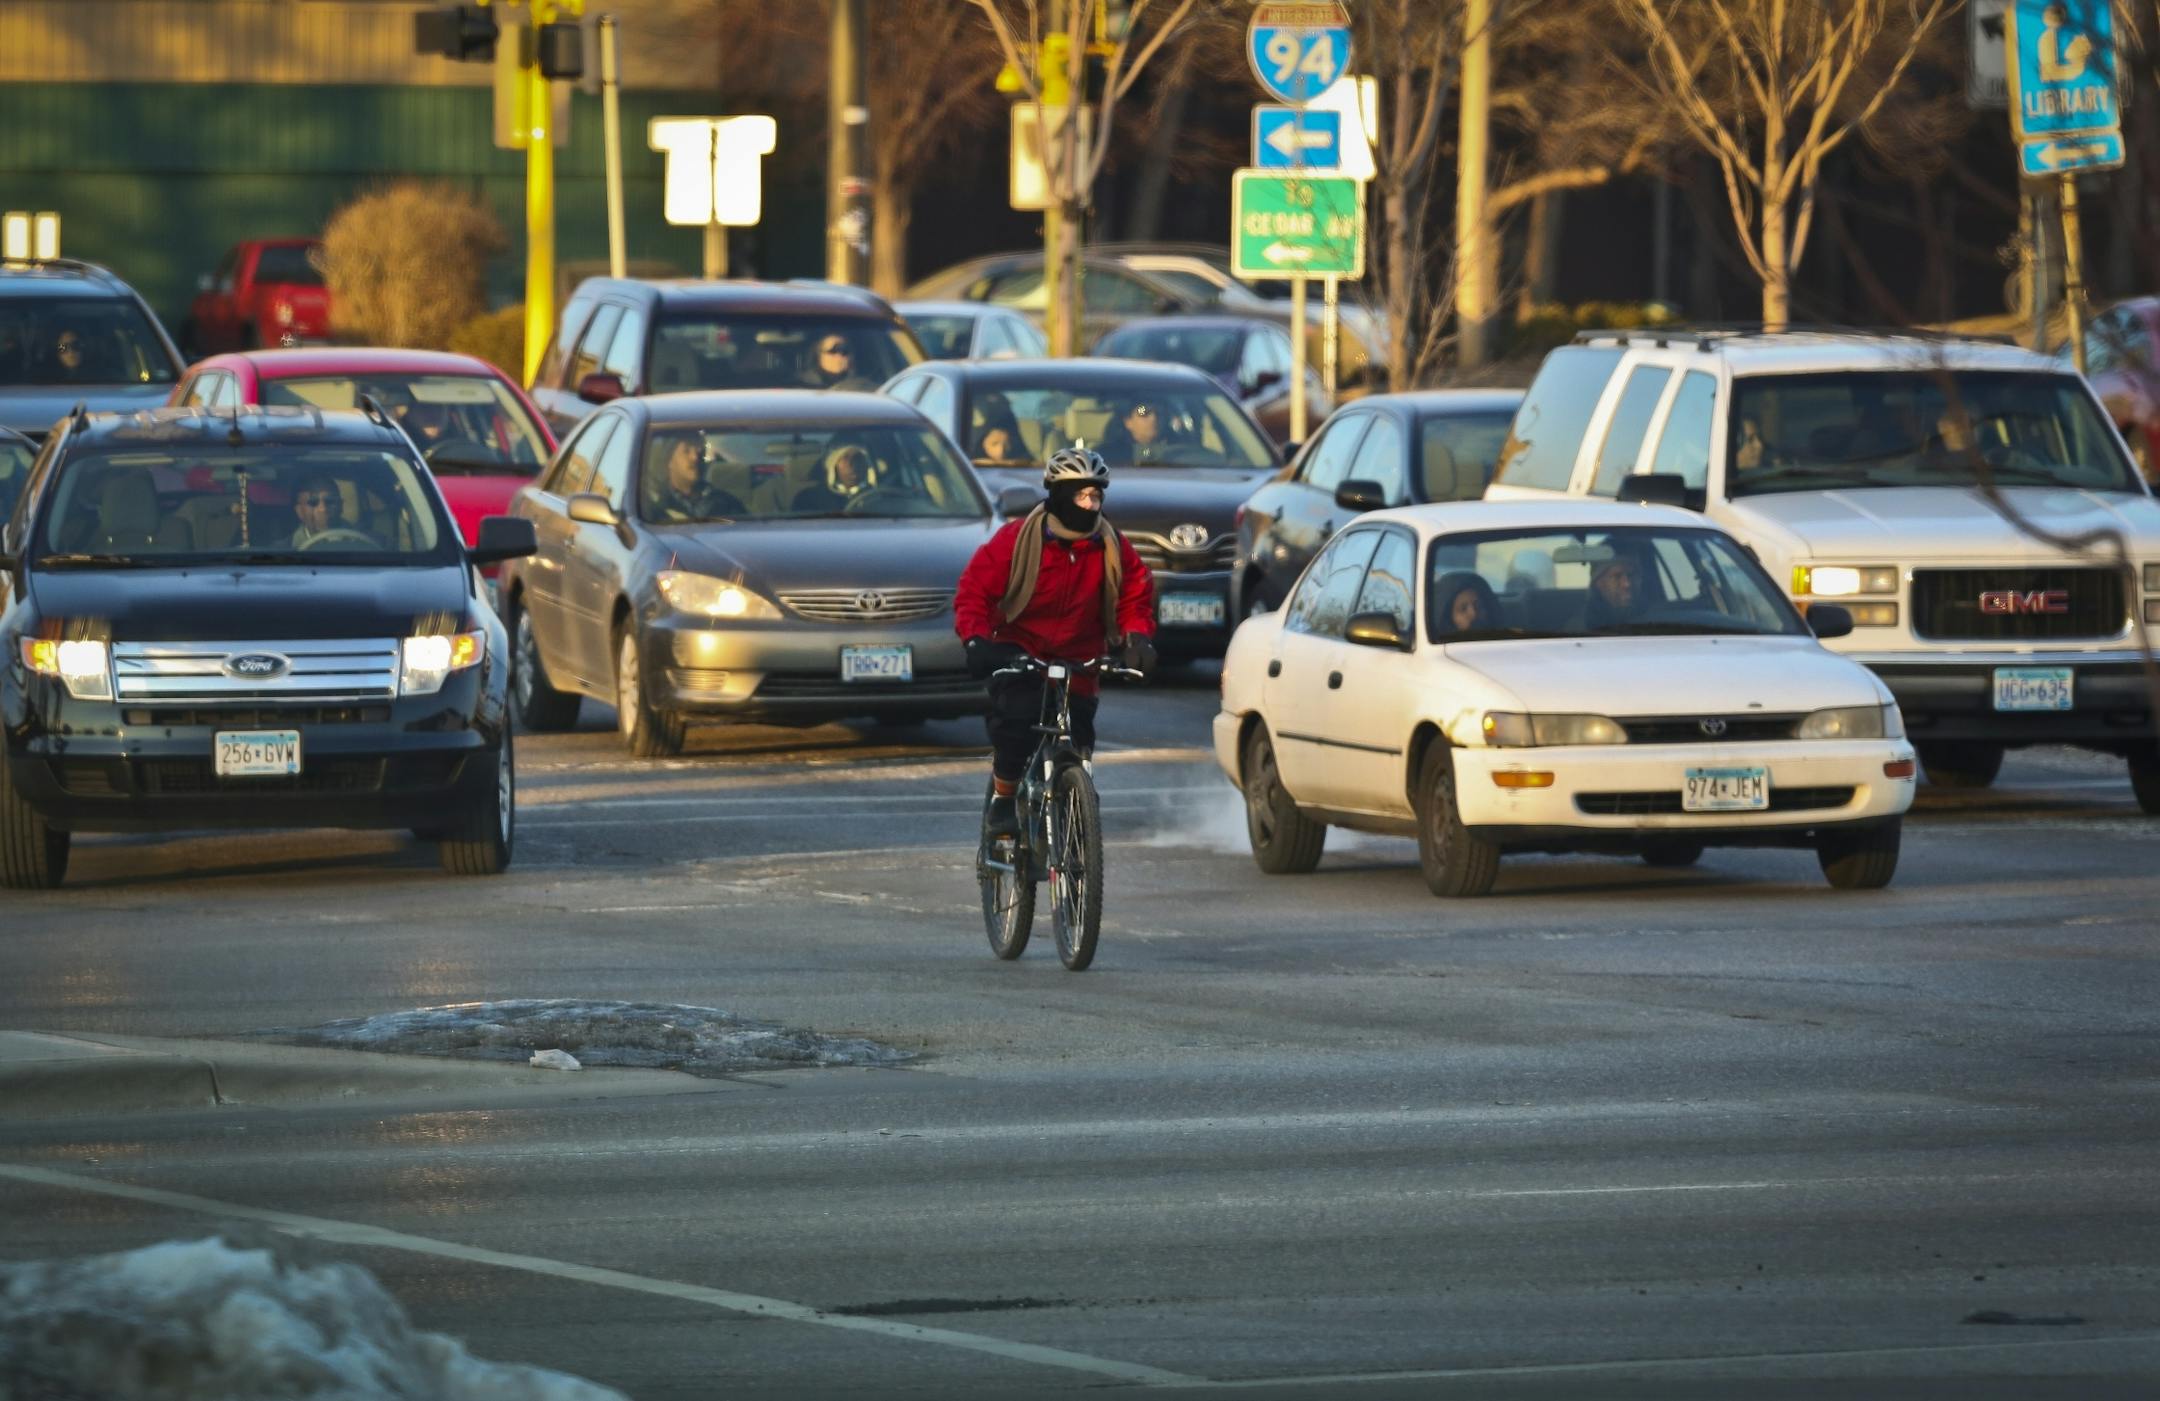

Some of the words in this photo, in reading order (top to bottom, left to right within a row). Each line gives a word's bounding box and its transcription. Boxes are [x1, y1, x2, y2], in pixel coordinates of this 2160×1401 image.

[1265, 32, 1336, 84] 94
[2025, 85, 2109, 117] LIBRARY
[1245, 212, 1313, 237] CEDAR
[1979, 591, 2068, 613] GMC
[239, 659, 273, 673] Ford
[222, 743, 252, 764] 256
[1687, 776, 1718, 799] 974
